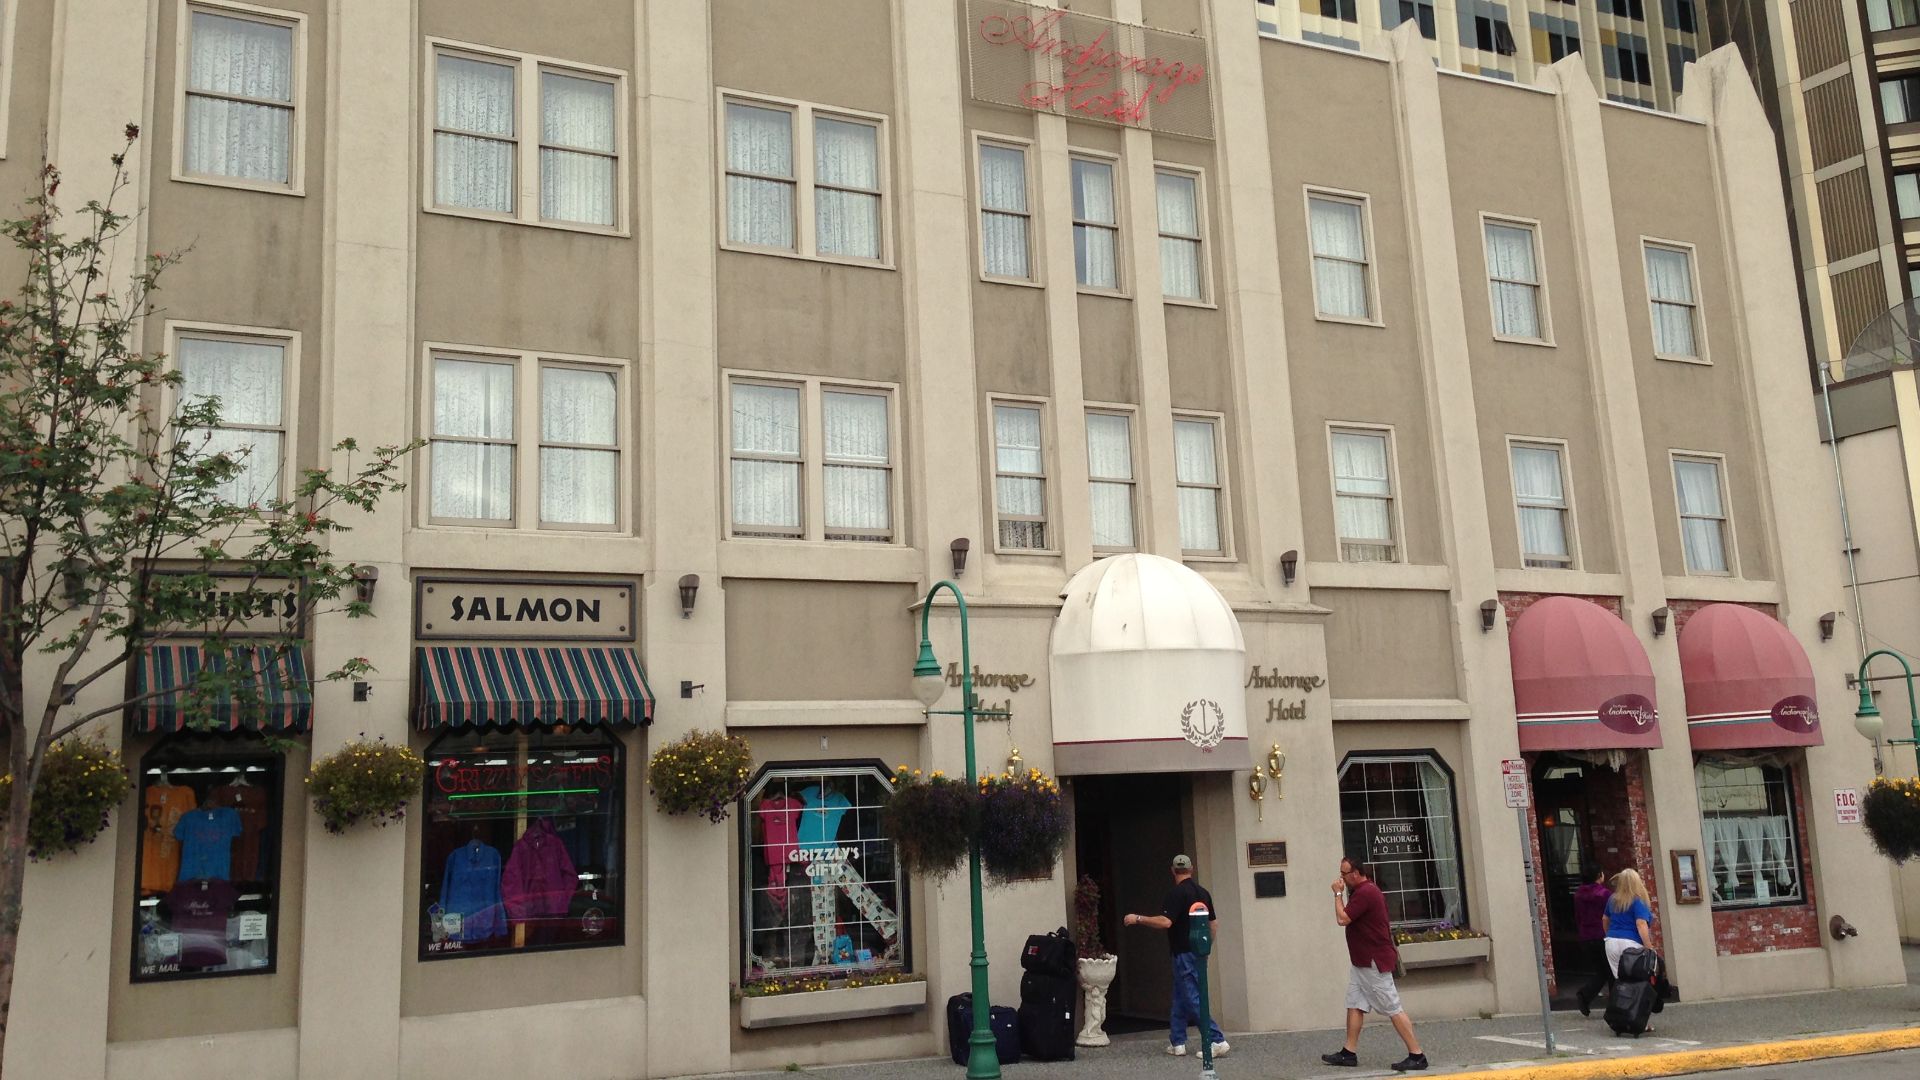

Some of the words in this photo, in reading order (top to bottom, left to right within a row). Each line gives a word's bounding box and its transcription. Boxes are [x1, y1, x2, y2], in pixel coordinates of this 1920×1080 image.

[450, 595, 600, 623] SALMON
[1244, 665, 1326, 693] Anchorage
[1266, 698, 1307, 723] Hotel
[1378, 823, 1414, 833] HISTORIC
[1374, 835, 1420, 844] ANCHORAGE
[788, 846, 860, 862] GRIZZLY'S
[805, 863, 844, 877] GIFTS
[428, 943, 441, 951] WE
[444, 941, 463, 950] MAIL
[141, 965, 156, 974] WE
[159, 963, 181, 973] MAIL
